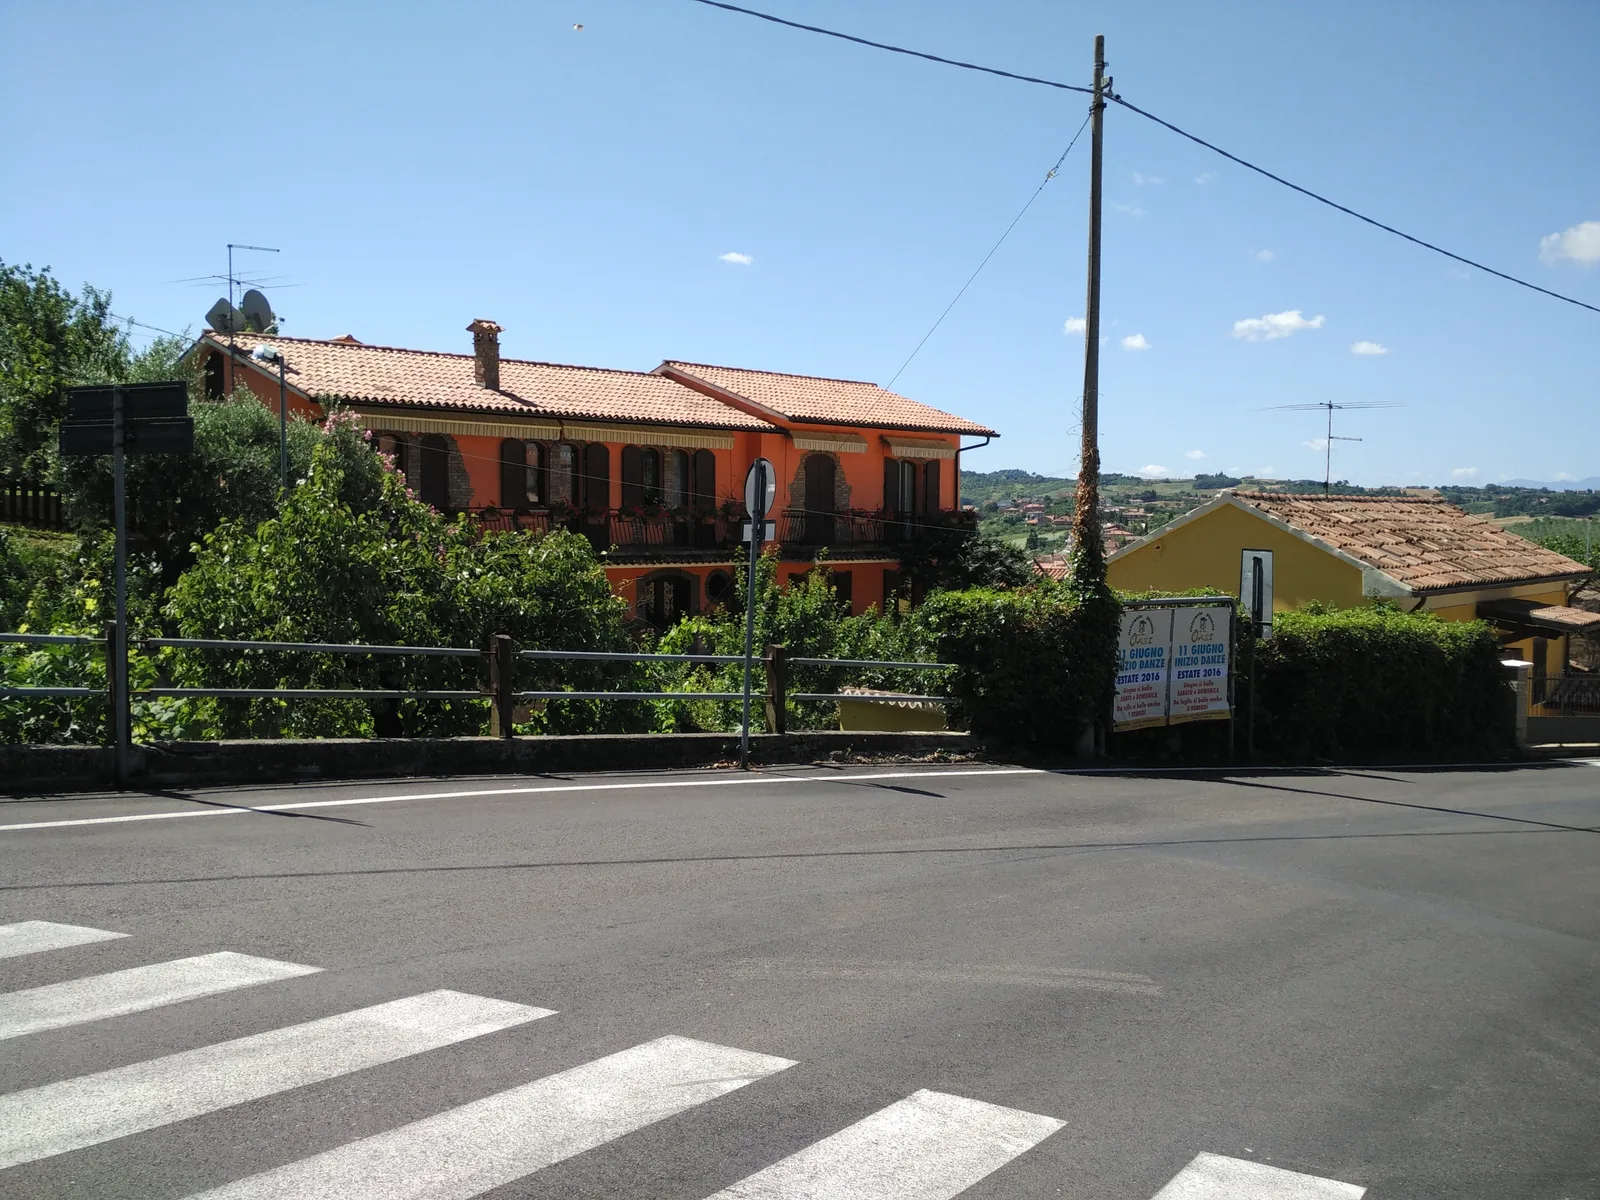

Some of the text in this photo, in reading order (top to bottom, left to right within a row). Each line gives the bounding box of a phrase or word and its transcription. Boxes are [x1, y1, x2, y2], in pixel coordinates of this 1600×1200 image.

[1130, 647, 1163, 659] GIUGNO
[1179, 643, 1224, 656] 11 GIUGNO
[1140, 658, 1165, 670] DANZE
[1174, 655, 1225, 667] INIZIO DANZE
[1117, 672, 1160, 685] ESTATE 2016
[1177, 668, 1221, 679] ESTATE 2016
